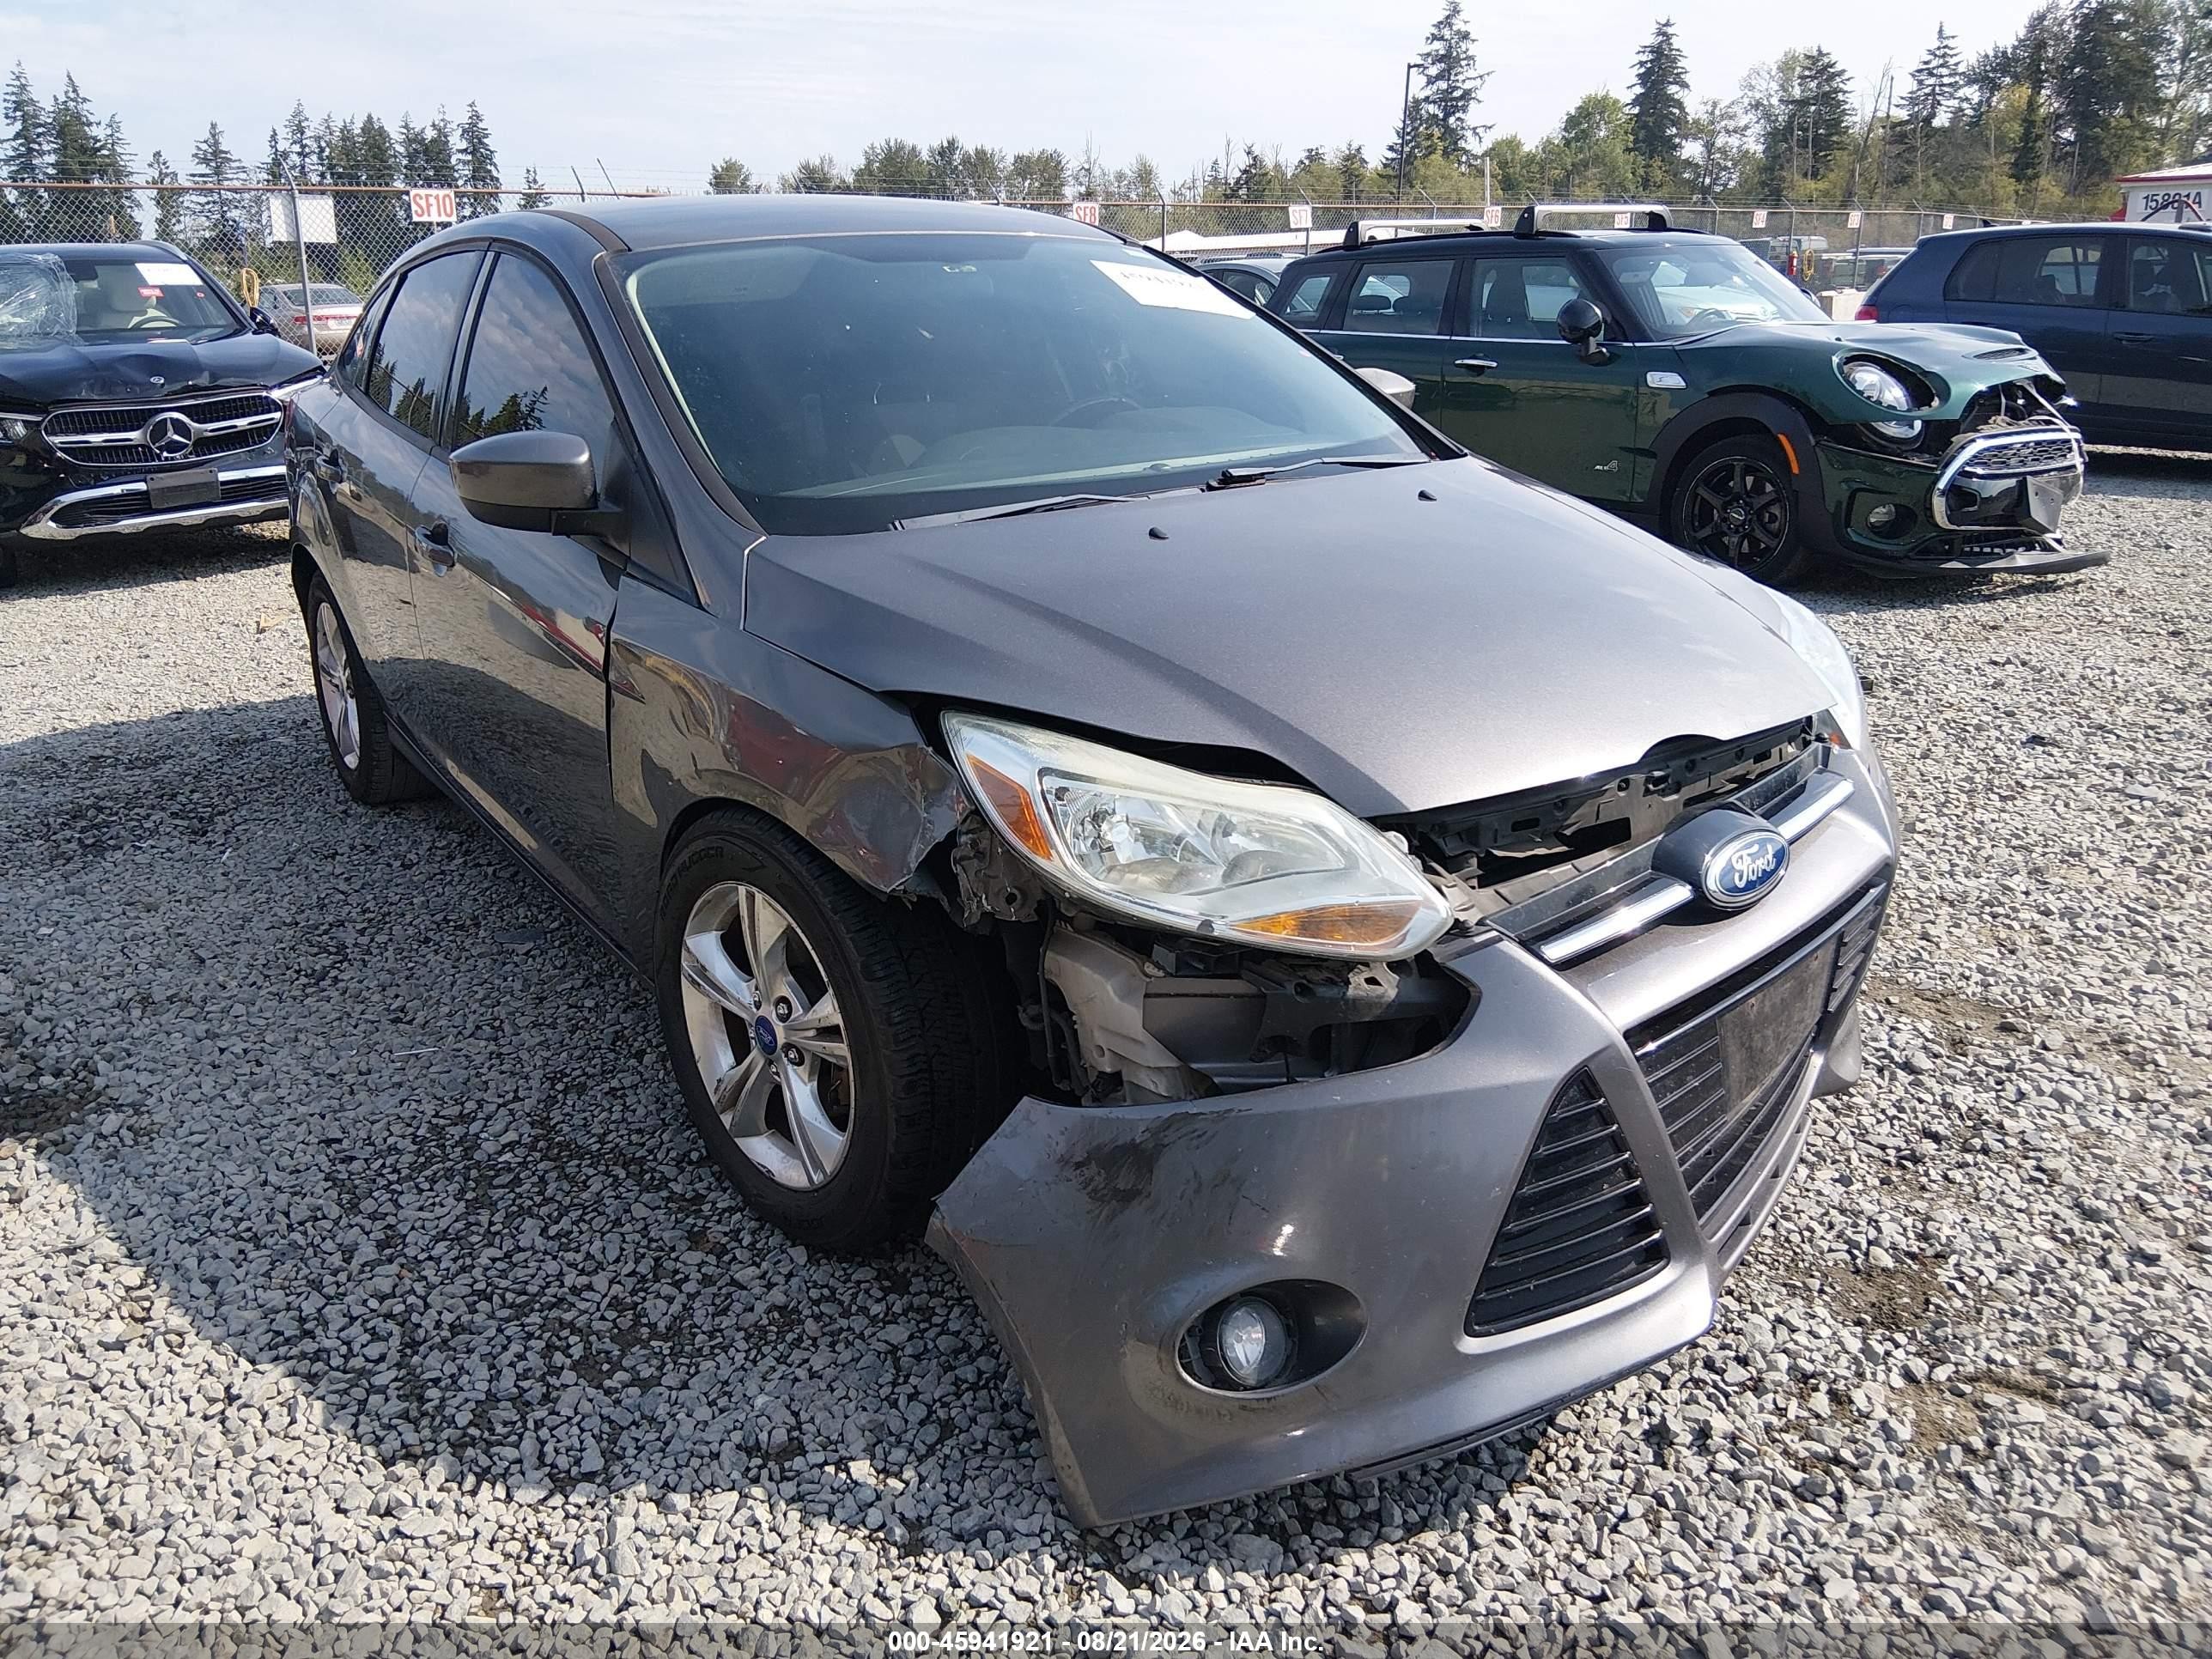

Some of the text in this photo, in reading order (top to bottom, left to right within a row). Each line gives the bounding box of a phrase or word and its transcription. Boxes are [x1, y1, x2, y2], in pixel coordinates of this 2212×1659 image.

[412, 193, 454, 217] SF10
[1075, 206, 1097, 224] SF8
[1291, 210, 1308, 226] SF7
[1486, 210, 1500, 224] SF6
[1731, 843, 1777, 888] Ford
